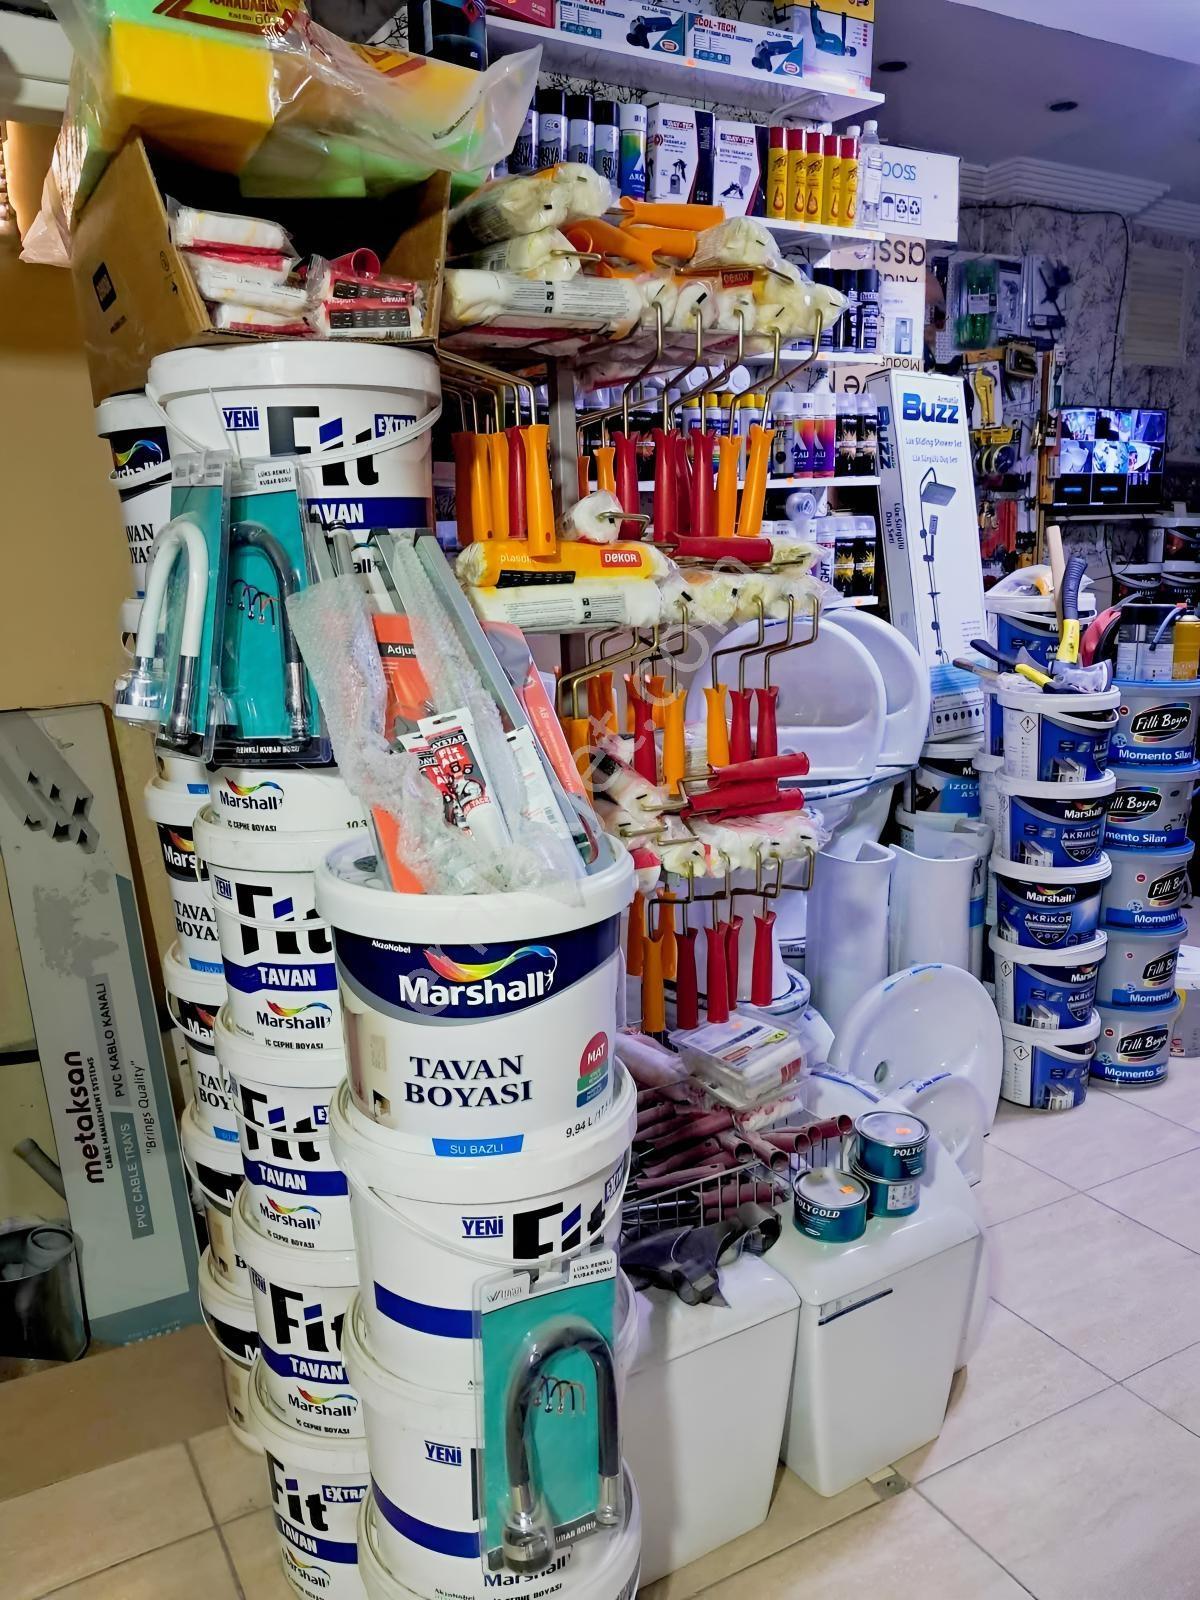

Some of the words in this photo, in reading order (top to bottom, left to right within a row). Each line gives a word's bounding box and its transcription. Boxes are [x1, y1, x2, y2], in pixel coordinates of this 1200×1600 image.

[223, 407, 259, 428] YENİ
[903, 392, 959, 424] Buzz
[310, 503, 364, 524] AVAN
[1135, 715, 1159, 731] Filli
[1161, 713, 1188, 730] Boya
[431, 734, 465, 750] AYSTAR
[1119, 749, 1172, 761] Momento
[220, 790, 278, 810] Marshall
[1110, 796, 1125, 809] illi
[1127, 796, 1158, 813] Boya
[1142, 833, 1168, 844] Silan
[1026, 890, 1072, 903] Marshall
[176, 916, 219, 941] BOYA
[257, 967, 317, 987] TAVAN
[399, 972, 545, 1007] Marshall
[95, 983, 112, 1027] KANALI
[257, 1011, 326, 1030] Marshall
[105, 1029, 120, 1071] KABLO
[587, 1043, 605, 1064] MAT
[1120, 1037, 1143, 1052] Filli
[409, 1055, 524, 1080] TAVAN
[1105, 1066, 1154, 1078] Momento
[112, 1073, 125, 1097] PVC
[404, 1080, 533, 1107] BOYASI
[64, 1051, 104, 1184] metaksan
[120, 1123, 135, 1159] TRAYS
[450, 1145, 466, 1155] SU
[470, 1143, 504, 1154] BAZLI
[127, 1163, 144, 1203] CABLE
[258, 1164, 307, 1191] TAVAN
[134, 1205, 147, 1228] PVC
[260, 1202, 316, 1230] Marshall
[462, 1215, 503, 1236] YENİ
[289, 1357, 344, 1381] TAVAN
[288, 1394, 352, 1417] Marshall
[425, 1443, 462, 1463] YENİ
[264, 1447, 328, 1531] Fit
